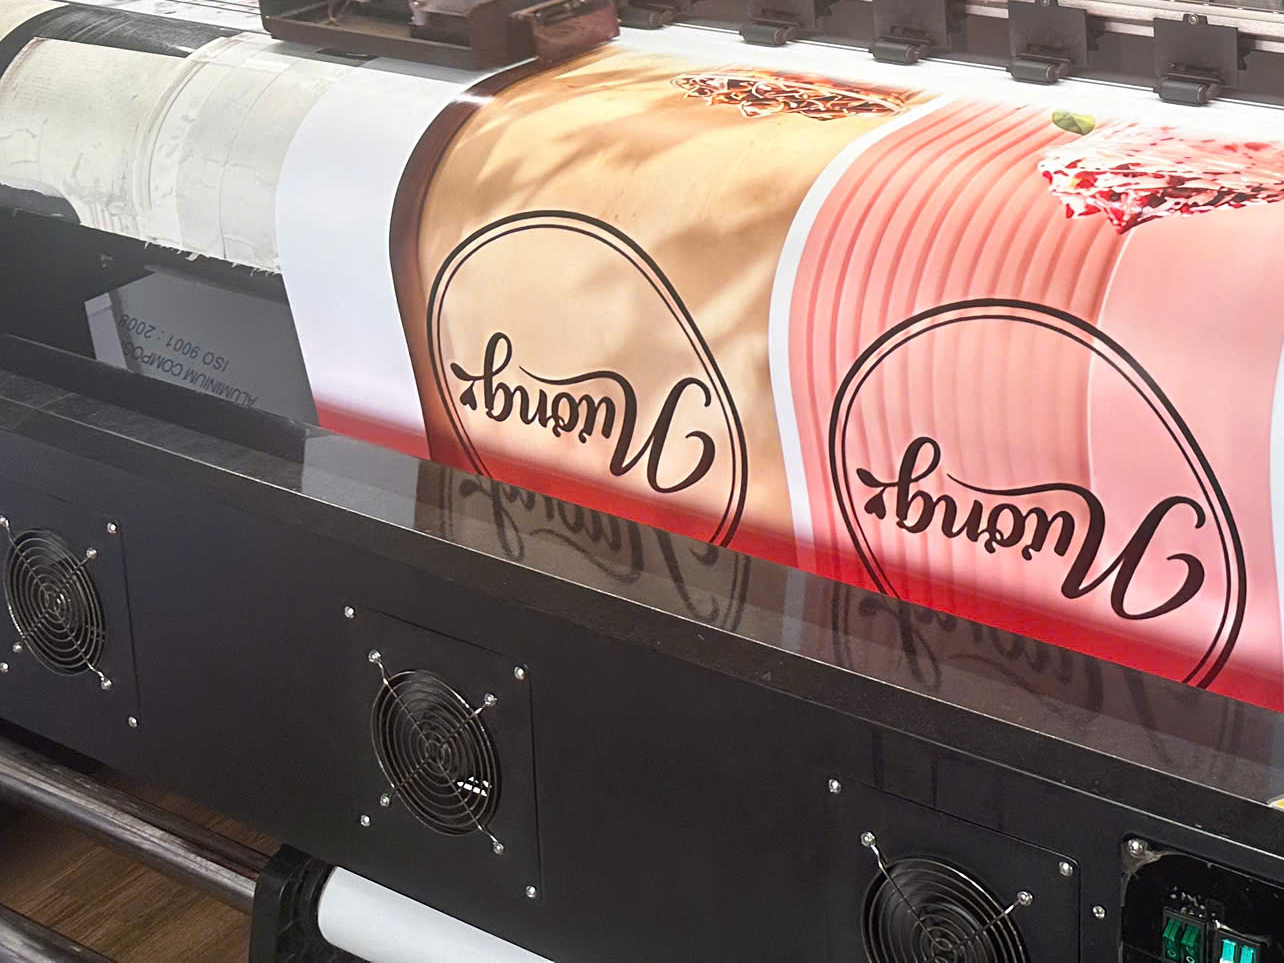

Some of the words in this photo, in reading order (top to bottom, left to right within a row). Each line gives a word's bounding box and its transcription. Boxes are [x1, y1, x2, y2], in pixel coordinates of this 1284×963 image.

[118, 313, 157, 338] 2008
[121, 341, 184, 376] COMPOS
[166, 334, 201, 360] 9001
[202, 351, 230, 373] ISO
